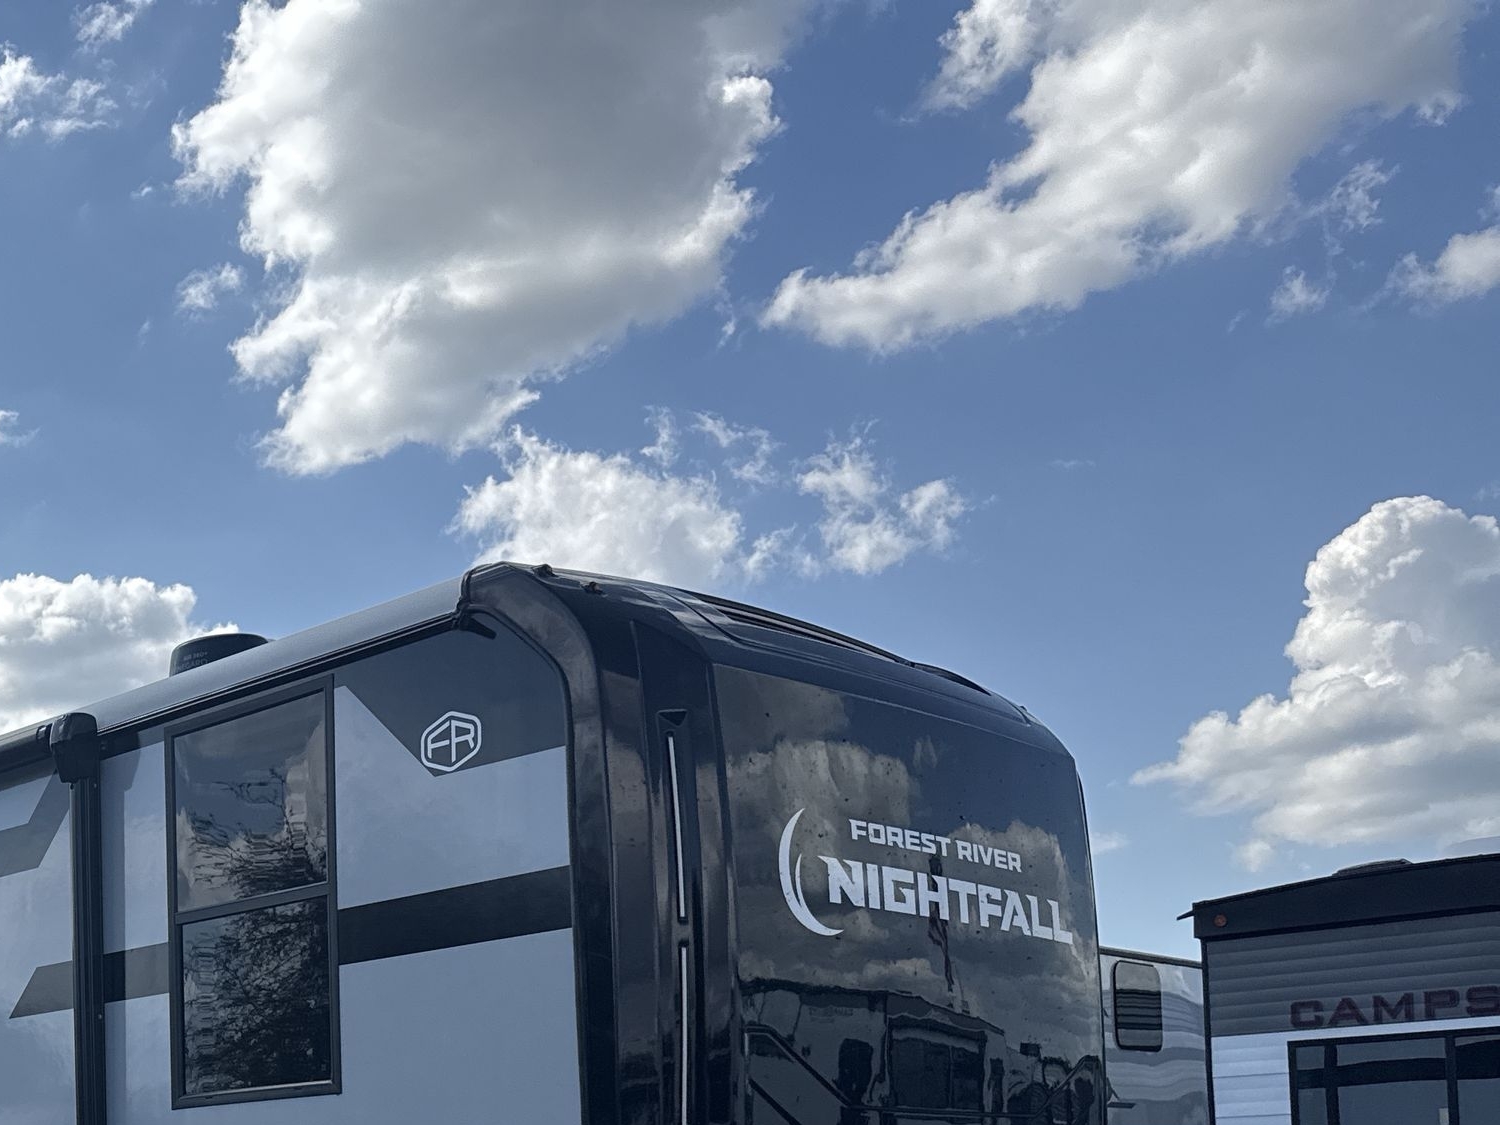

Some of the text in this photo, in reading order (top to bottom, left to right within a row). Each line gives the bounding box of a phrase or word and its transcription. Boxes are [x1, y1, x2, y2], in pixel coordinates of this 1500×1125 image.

[426, 717, 476, 765] FR
[849, 818, 1022, 873] FOREST RIVER
[817, 855, 1074, 945] NIGHTFALL
